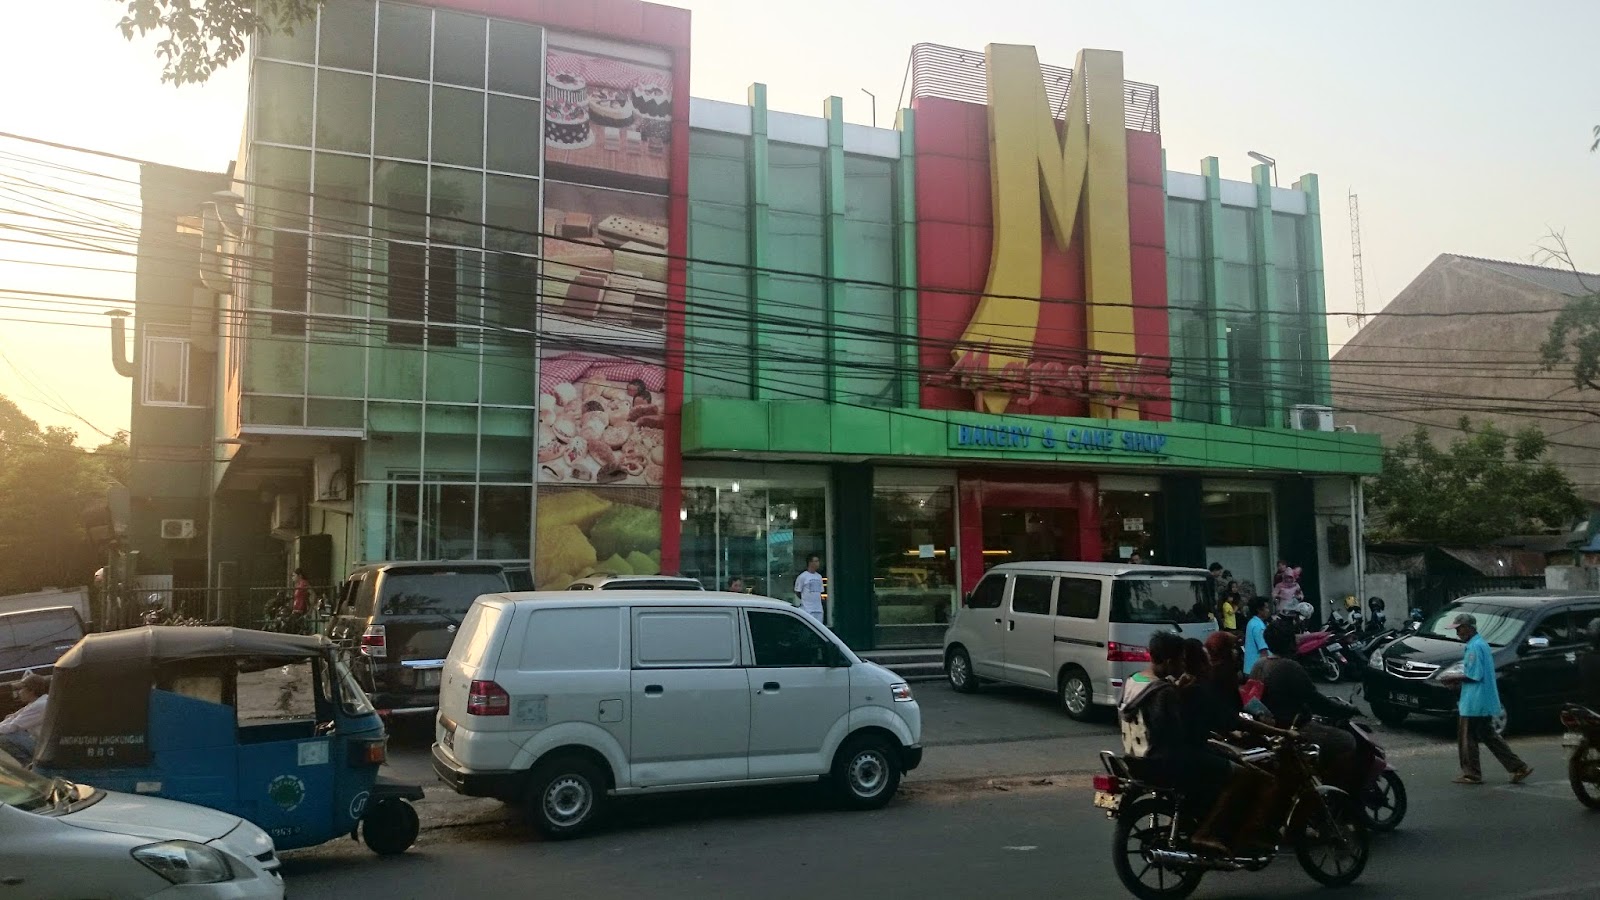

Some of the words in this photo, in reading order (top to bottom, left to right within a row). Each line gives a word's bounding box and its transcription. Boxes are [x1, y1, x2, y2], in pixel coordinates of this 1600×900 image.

[958, 424, 1033, 449] BAKERY
[1042, 427, 1056, 449] &
[1067, 428, 1114, 452] CAKE
[1121, 431, 1167, 454] SHOP
